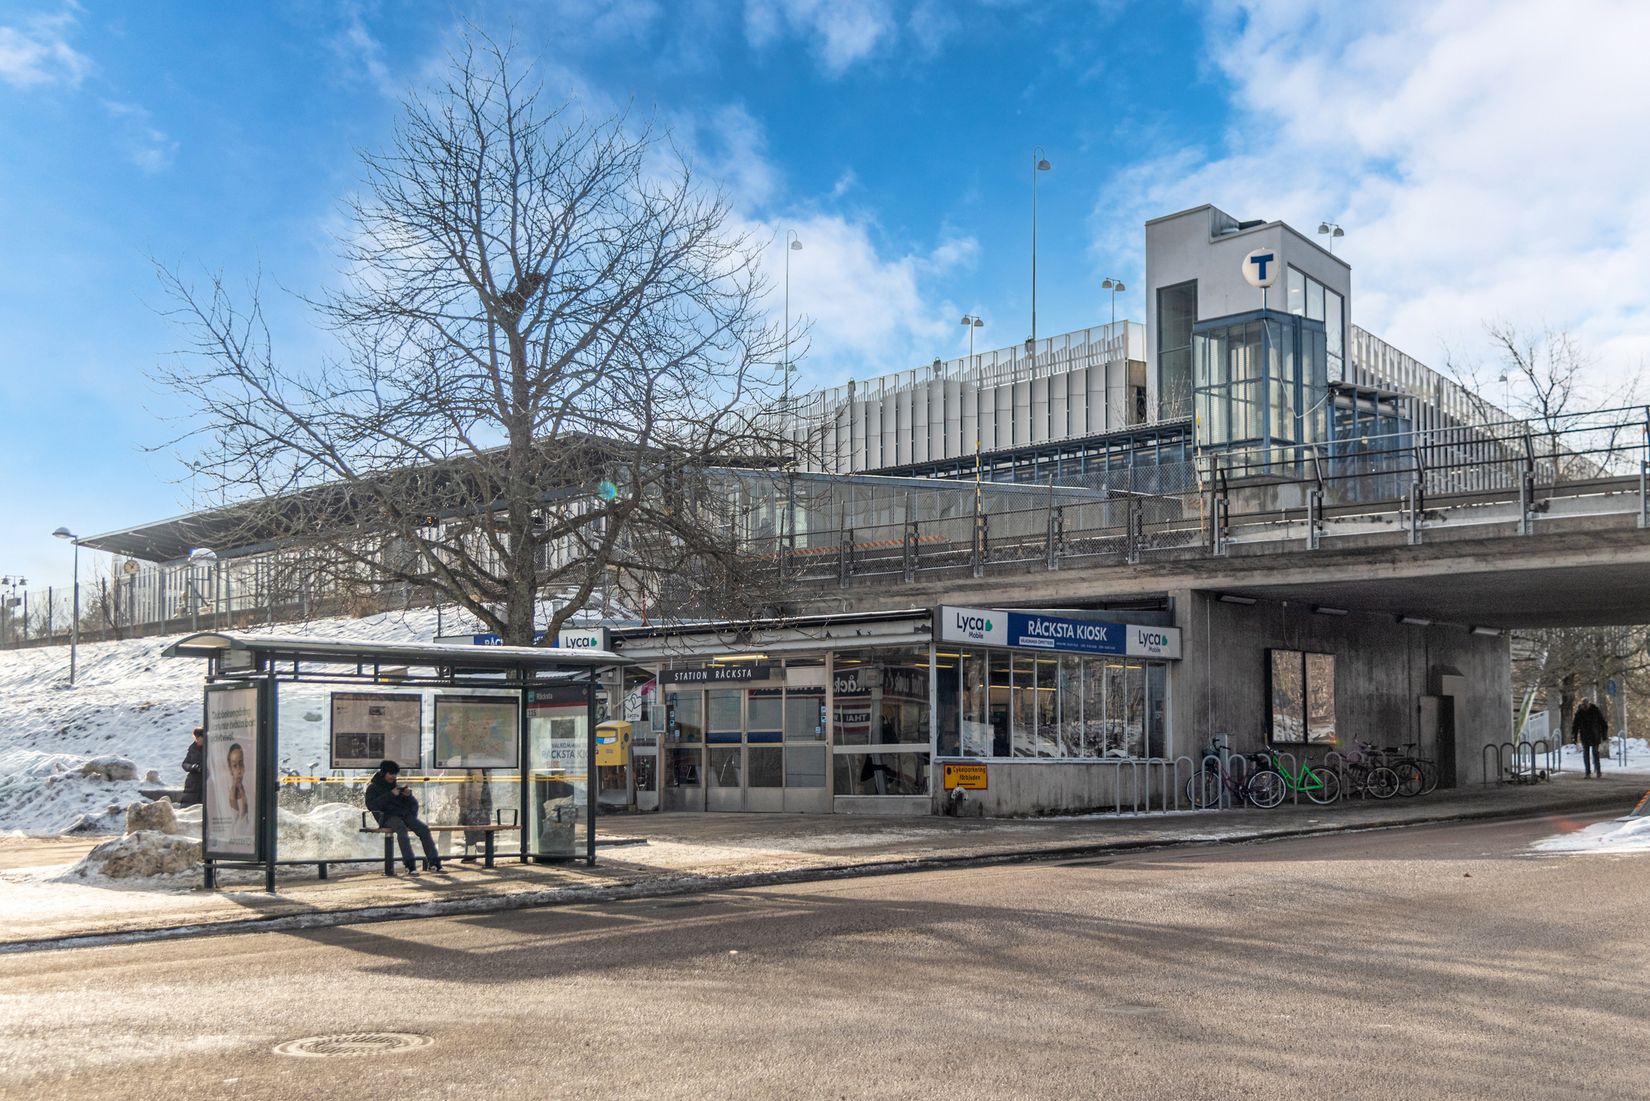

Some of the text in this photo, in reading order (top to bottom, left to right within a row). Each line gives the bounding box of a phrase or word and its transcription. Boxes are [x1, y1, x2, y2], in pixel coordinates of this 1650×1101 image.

[1250, 252, 1274, 281] T
[956, 612, 984, 633] Lyca
[1028, 618, 1108, 642] RÅCKSTA KIOSK
[565, 636, 590, 649] Lyca
[968, 631, 984, 640] Mobile
[1138, 629, 1161, 647] Lyca
[674, 667, 752, 681] STATION RÅCKSTA
